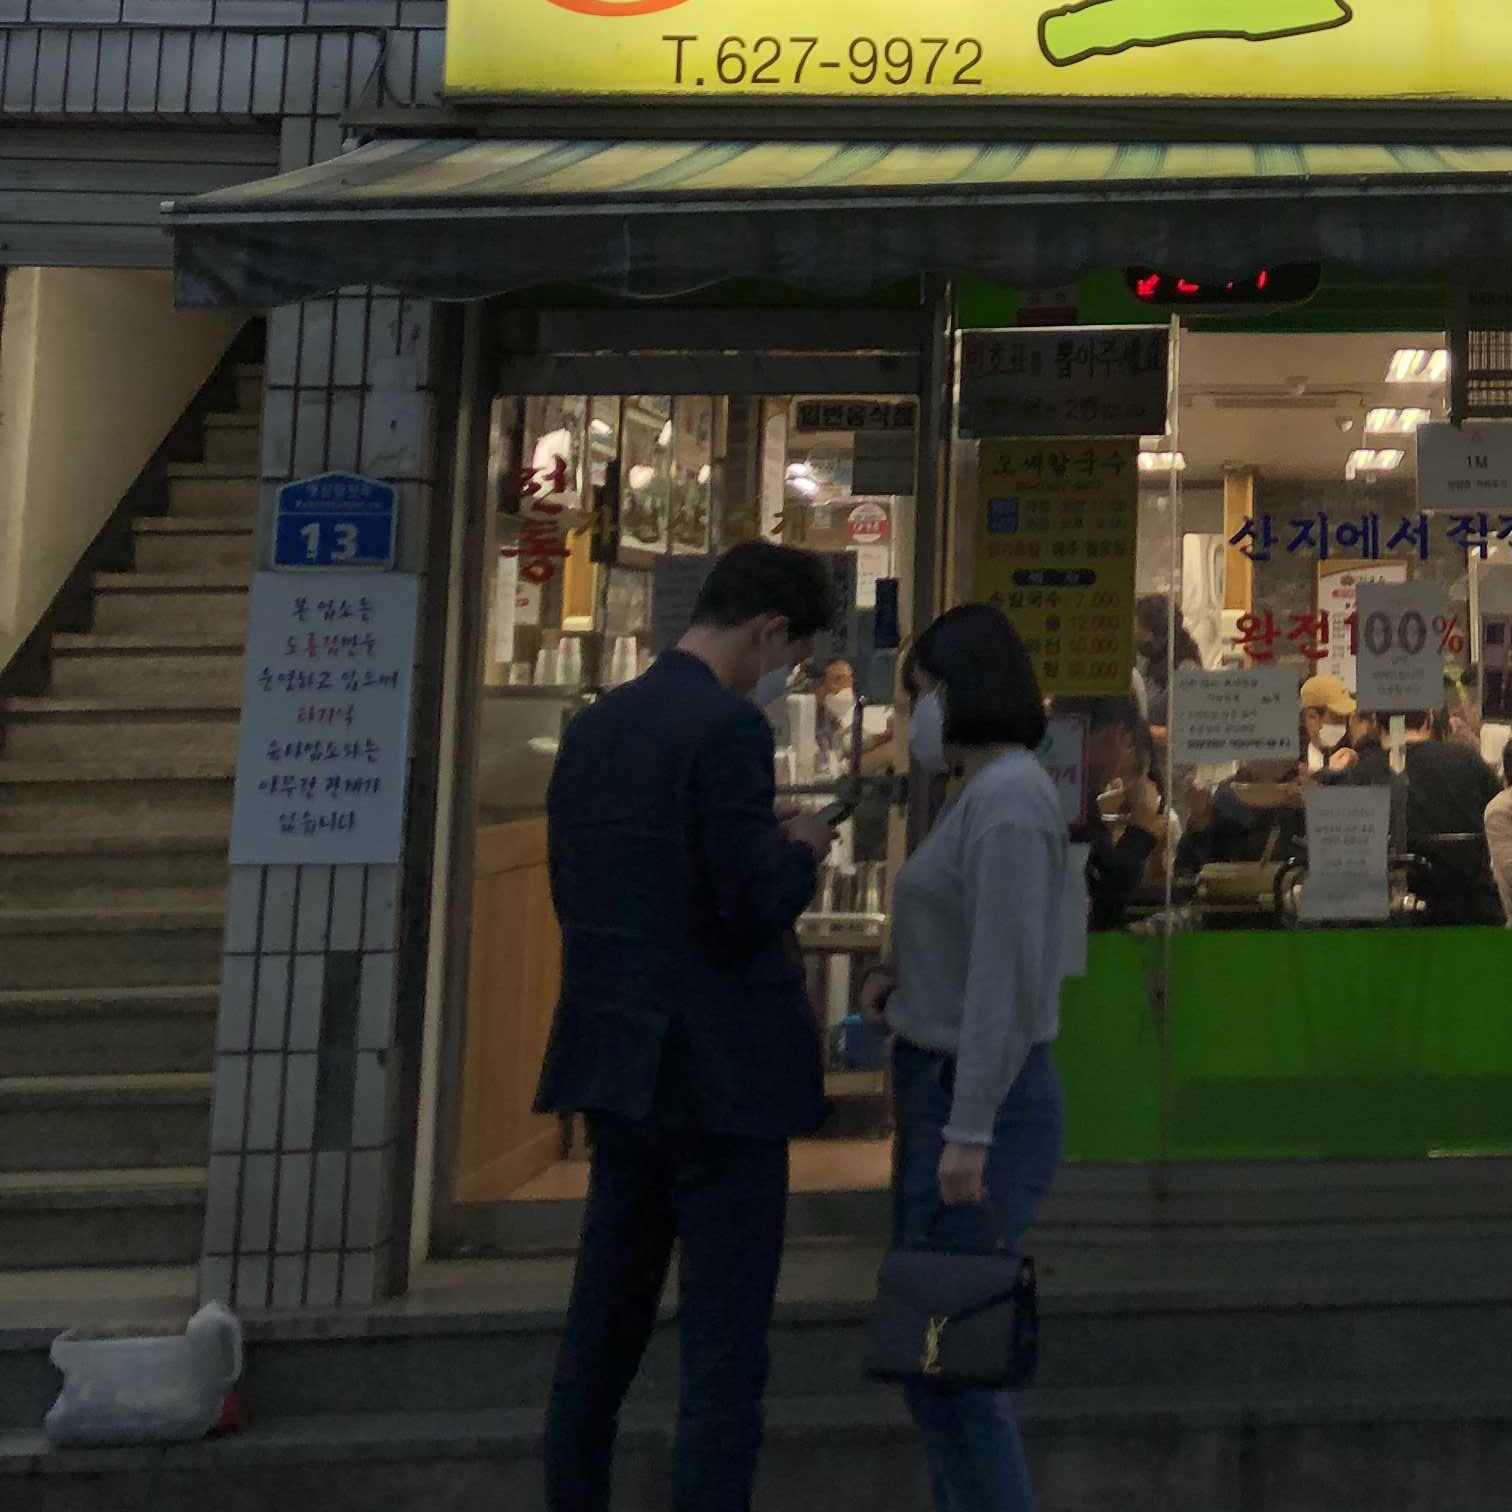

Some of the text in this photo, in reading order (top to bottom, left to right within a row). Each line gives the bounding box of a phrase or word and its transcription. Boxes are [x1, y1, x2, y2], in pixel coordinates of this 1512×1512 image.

[661, 35, 984, 86] T.627-9972
[299, 521, 360, 561] 13
[1228, 512, 1433, 561] 산지에서
[317, 595, 373, 621] 업소는
[1234, 610, 1464, 661] 완전 100%
[279, 809, 356, 837] 없습니다
